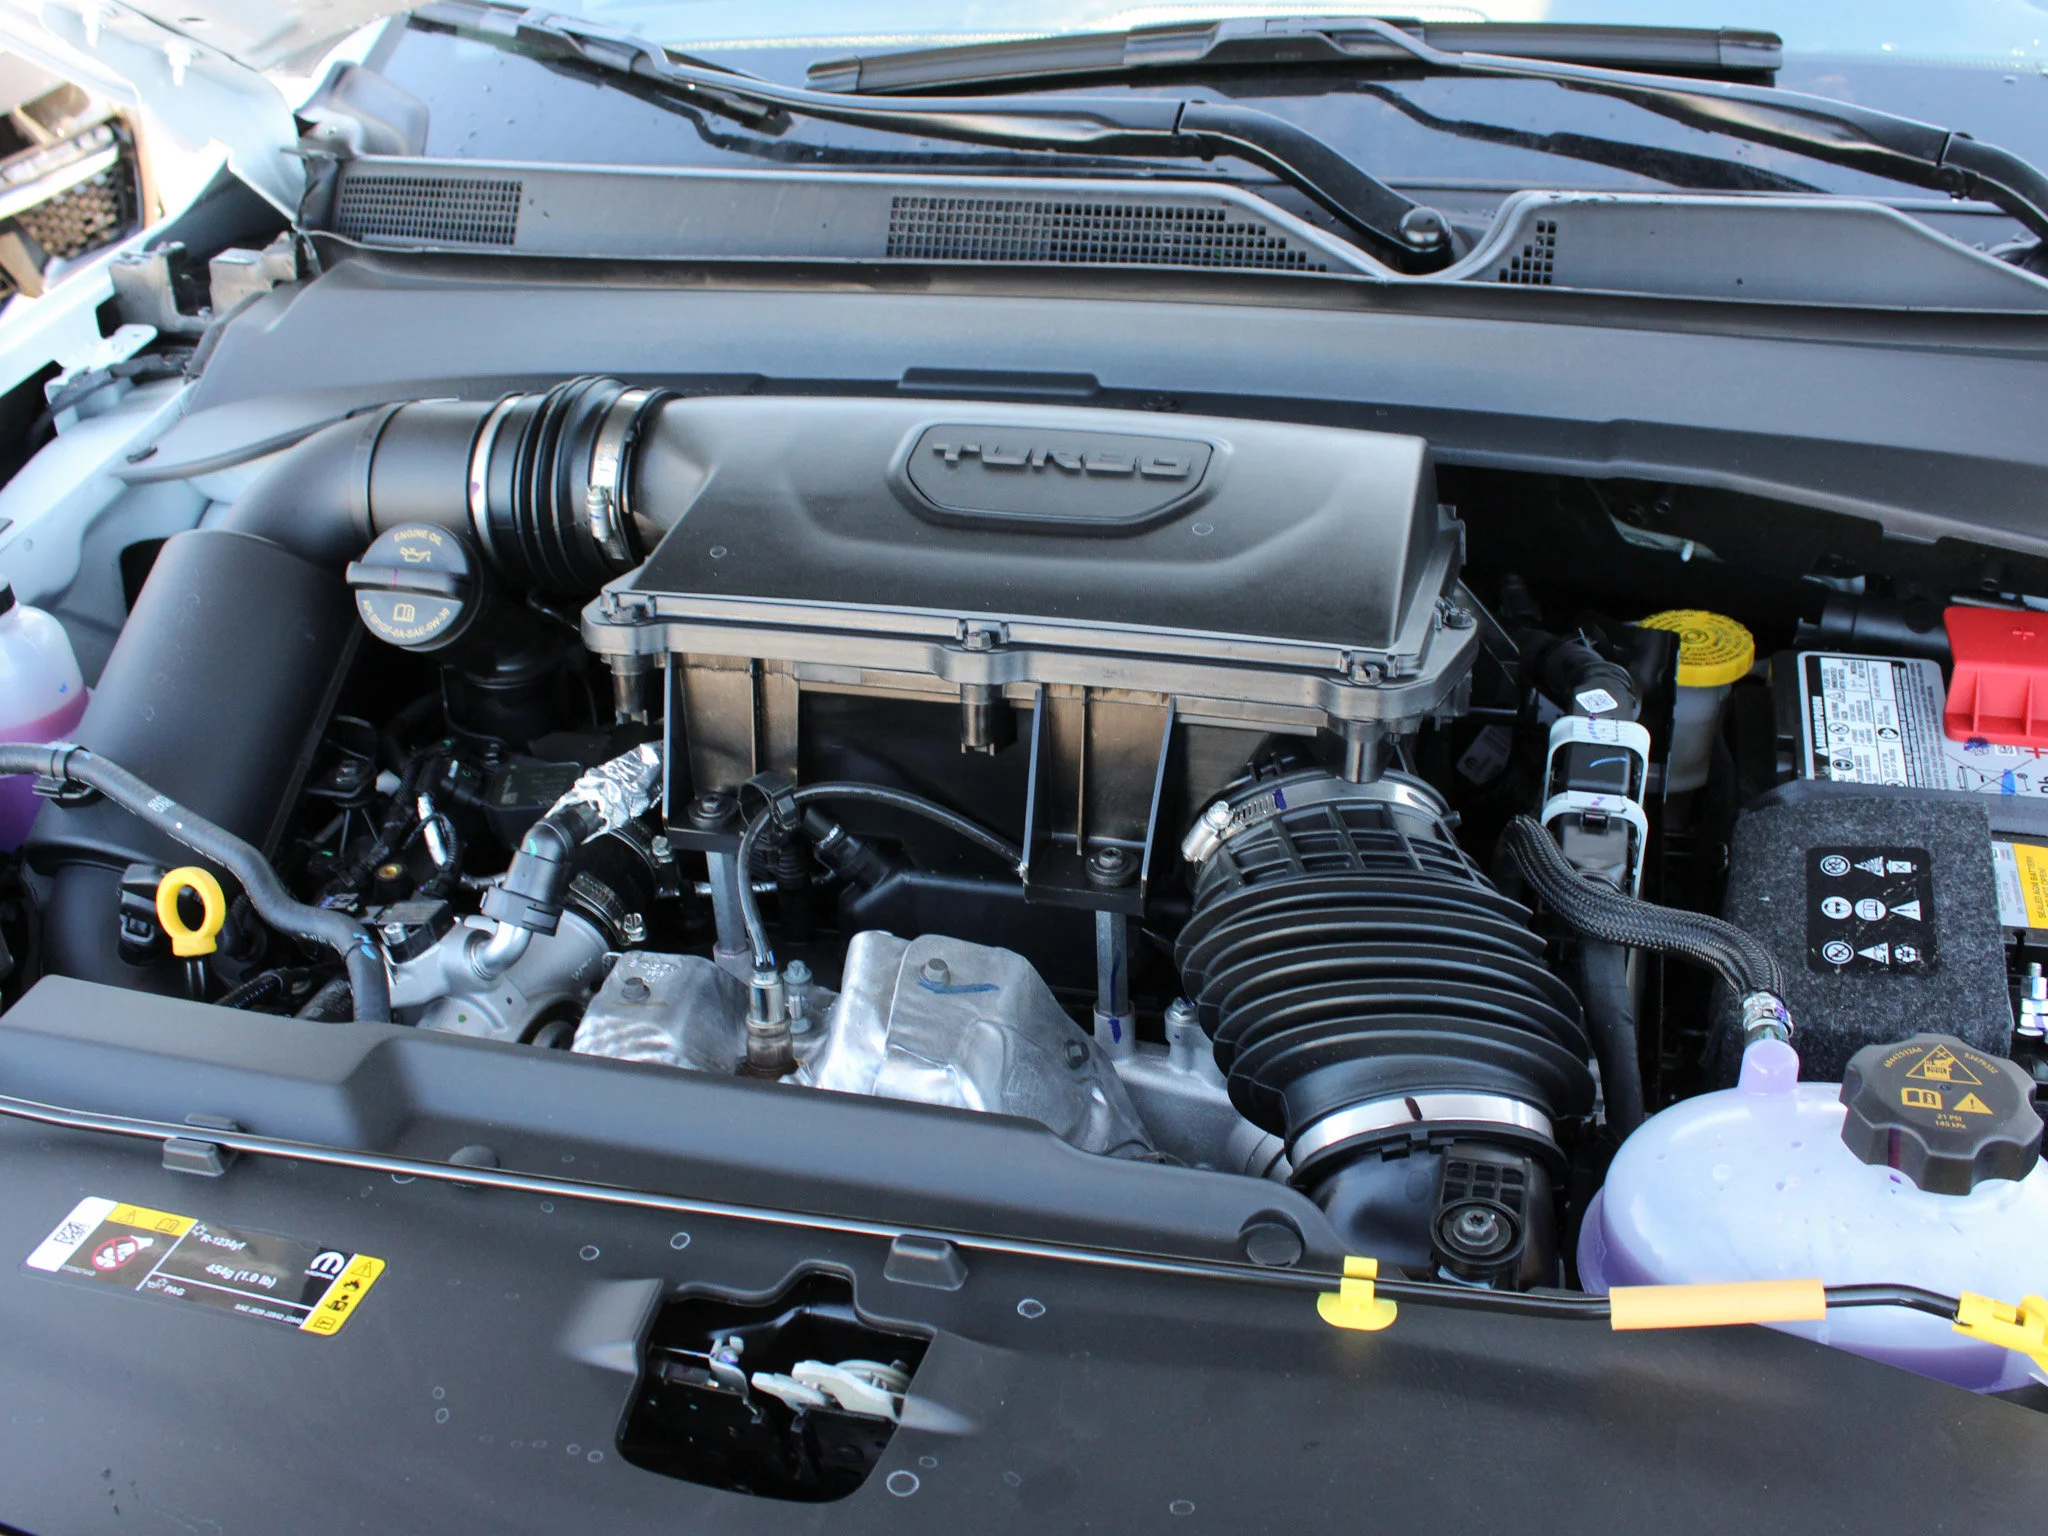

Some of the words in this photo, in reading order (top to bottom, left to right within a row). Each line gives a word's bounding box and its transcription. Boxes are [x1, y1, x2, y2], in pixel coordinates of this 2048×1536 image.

[932, 441, 1191, 478] TURBO
[393, 529, 429, 542] ENGINE
[200, 1234, 247, 1251] R-1234yf
[205, 1263, 236, 1280] 454g
[163, 1284, 186, 1296] PAG
